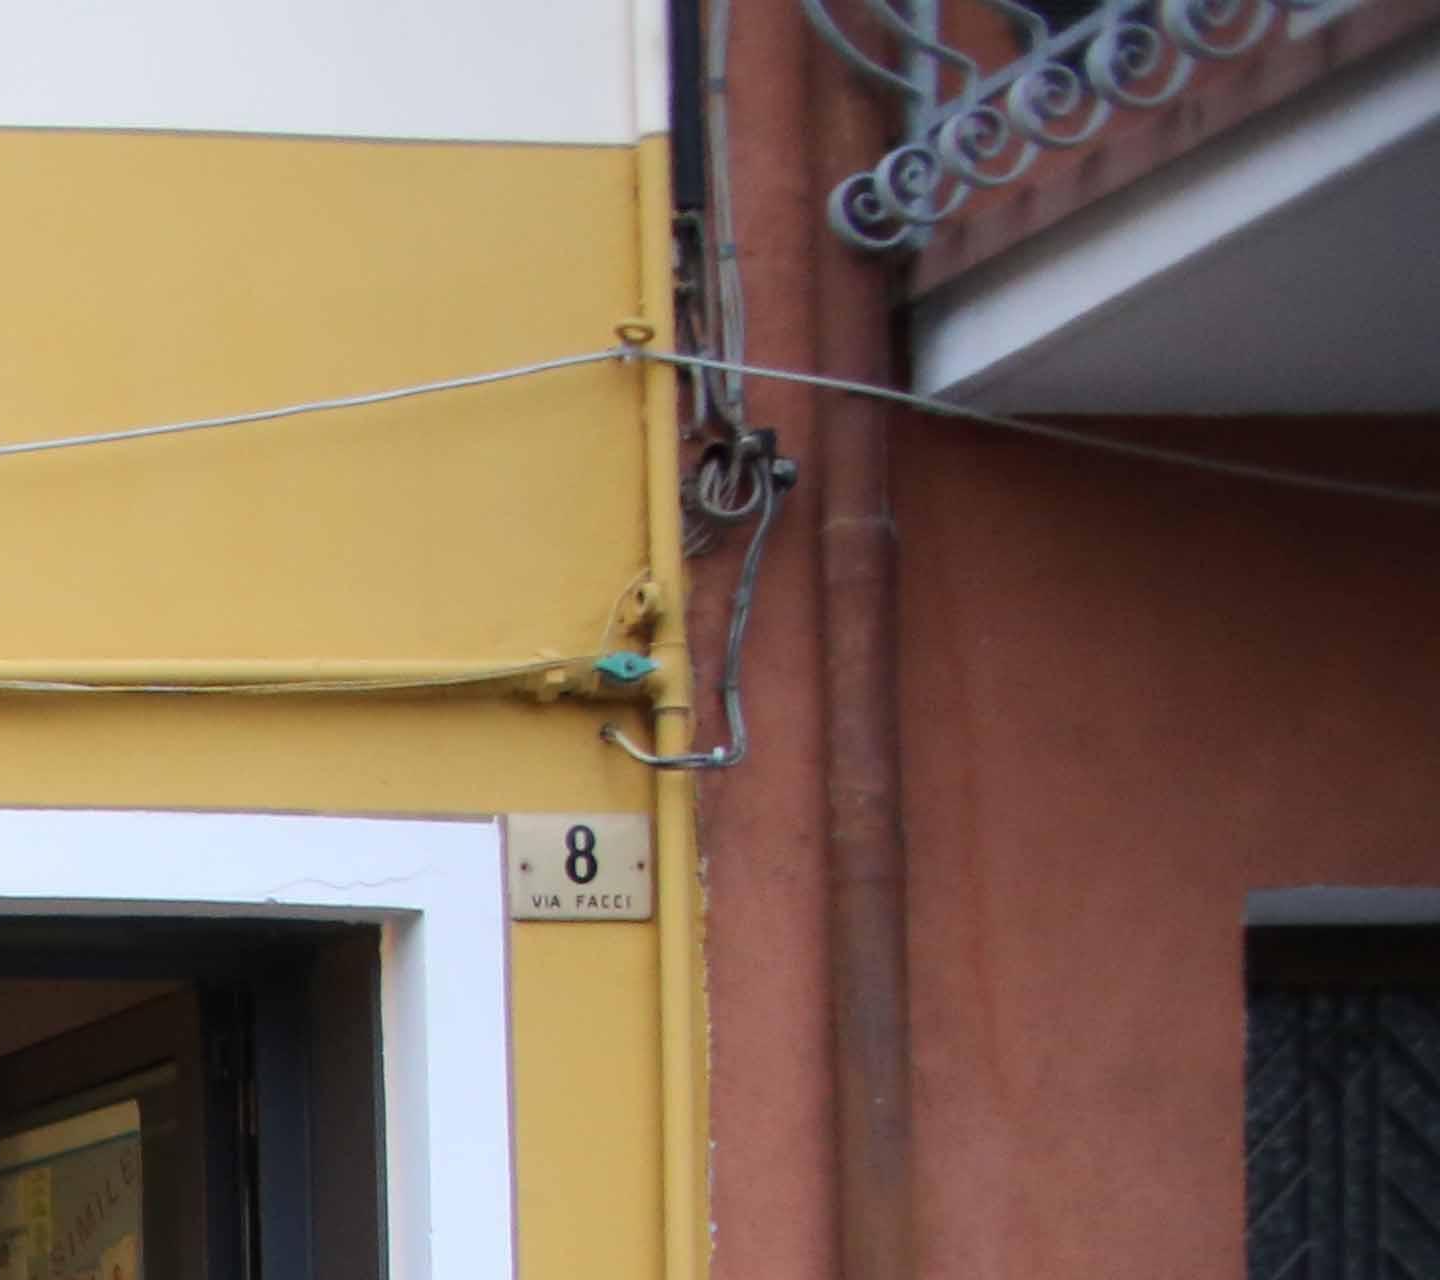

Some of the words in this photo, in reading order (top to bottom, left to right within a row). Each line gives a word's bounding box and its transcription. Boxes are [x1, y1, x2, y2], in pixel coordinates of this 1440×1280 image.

[565, 824, 598, 884] 8
[531, 895, 561, 909] VIA
[575, 894, 632, 909] FACCI
